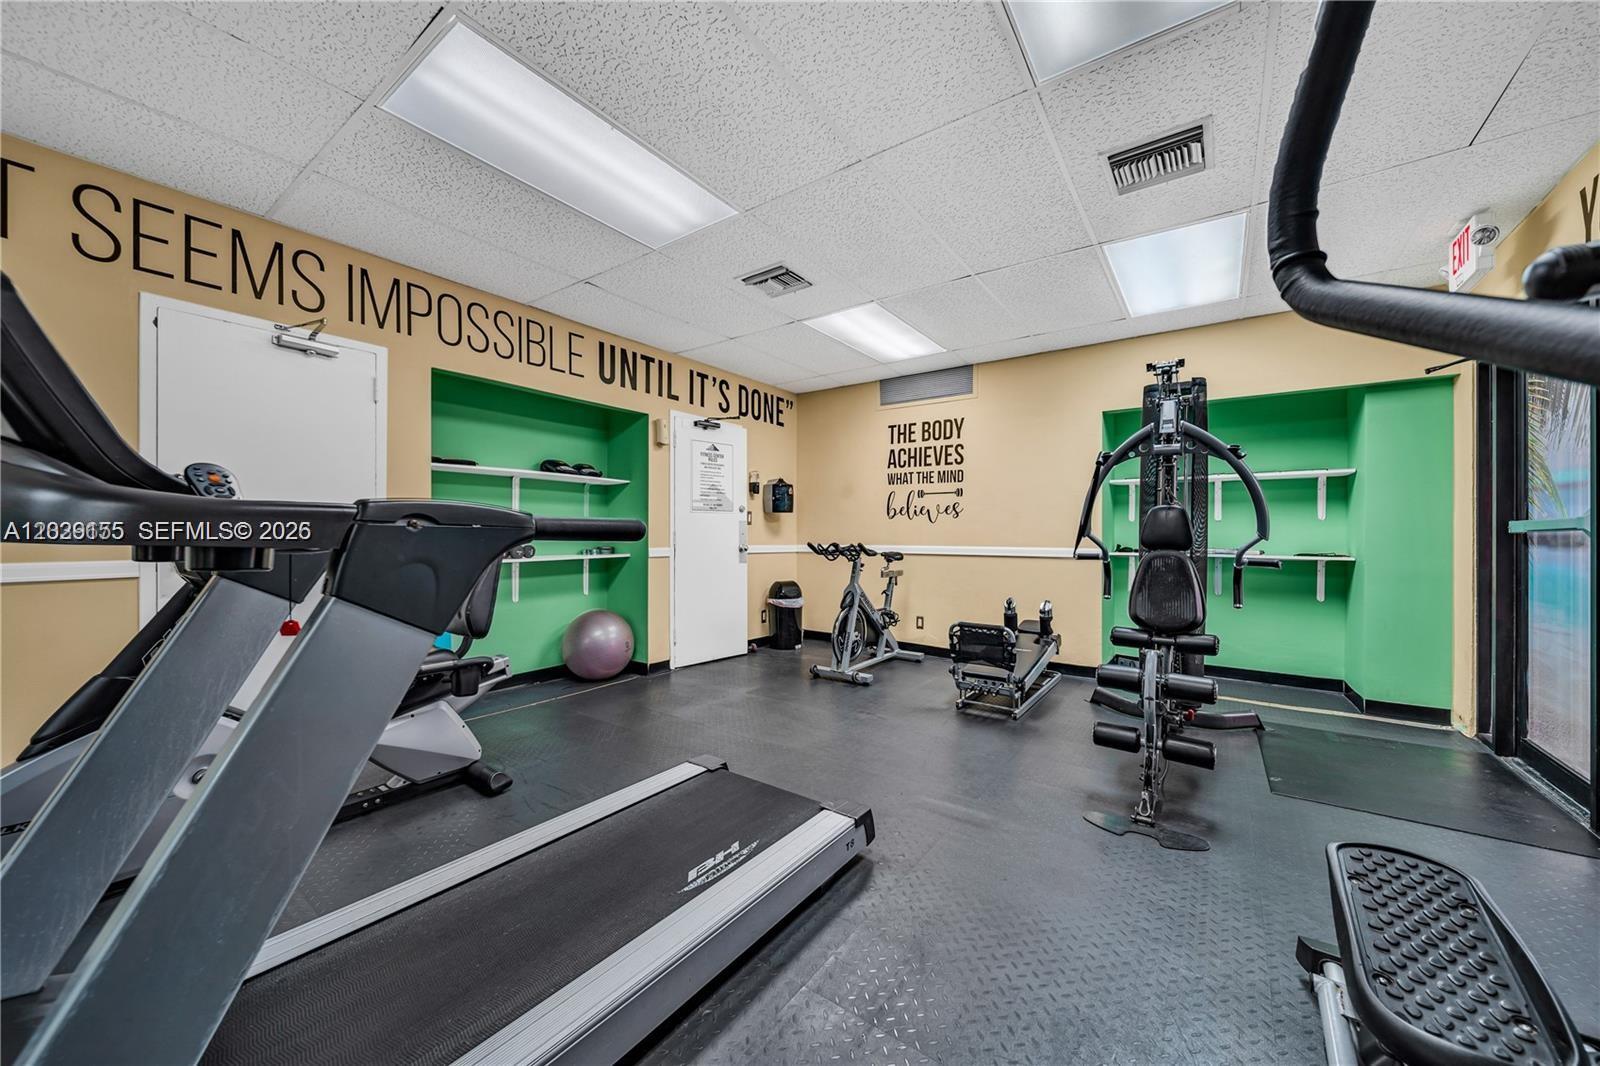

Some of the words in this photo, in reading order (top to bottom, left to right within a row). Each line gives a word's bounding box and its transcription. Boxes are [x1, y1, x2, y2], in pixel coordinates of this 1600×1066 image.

[1452, 224, 1471, 276] EXIT
[71, 184, 326, 313] SEEMS
[348, 264, 585, 378] IMPOSSIBLE
[598, 341, 679, 401] UNTIL
[689, 369, 731, 413] IT'S
[888, 422, 917, 444] THE
[921, 417, 965, 442] BODY
[887, 443, 965, 469] ACHIEVES
[887, 471, 914, 485] WHAT
[916, 470, 935, 484] THE
[937, 469, 964, 483] MIND
[886, 489, 964, 524] believes
